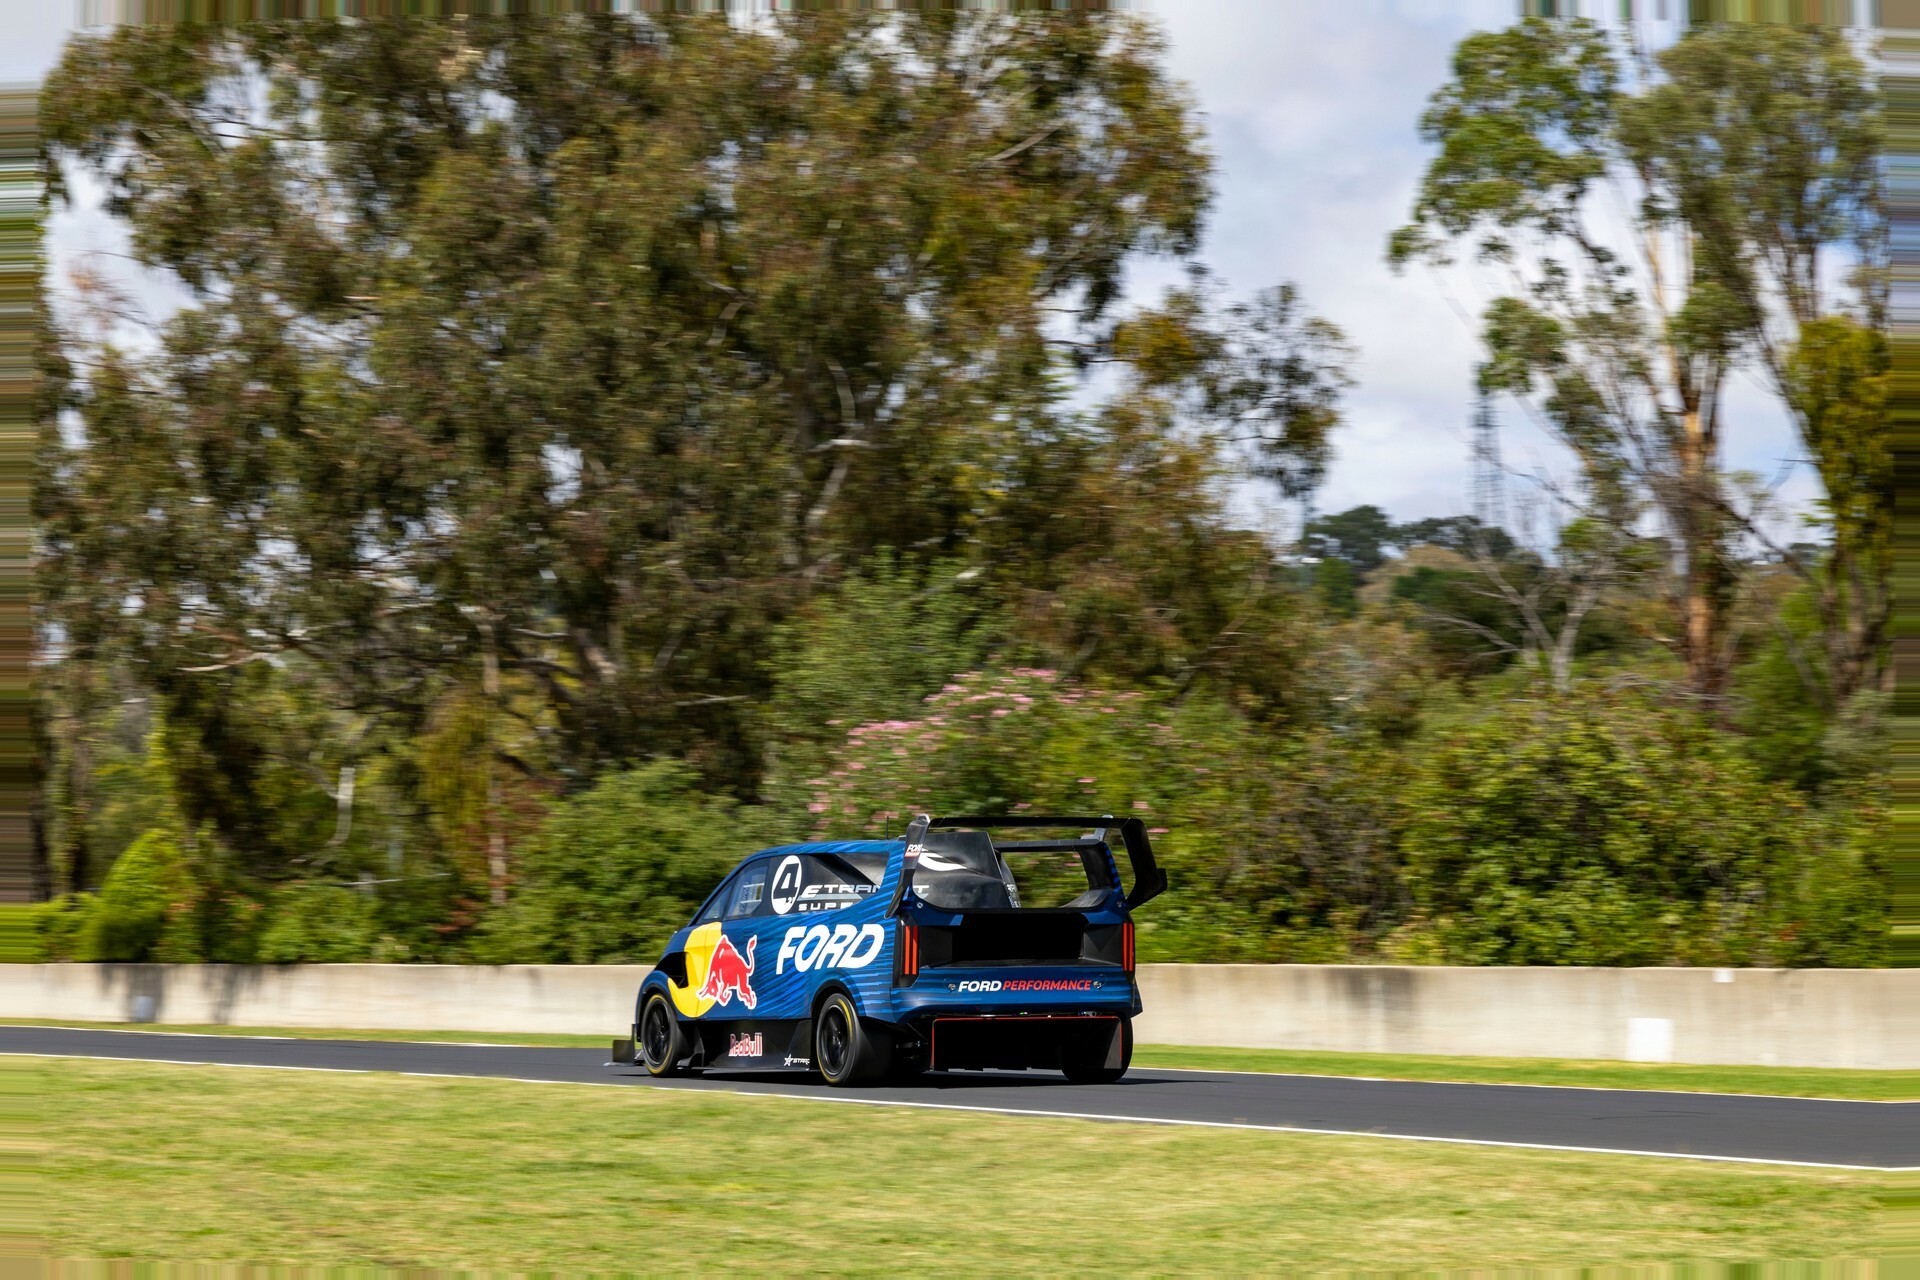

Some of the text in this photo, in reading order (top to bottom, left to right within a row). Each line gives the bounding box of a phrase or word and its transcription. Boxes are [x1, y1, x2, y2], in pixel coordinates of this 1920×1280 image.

[776, 924, 885, 975] FORD
[958, 980, 1092, 992] FORD PERFORMANCE
